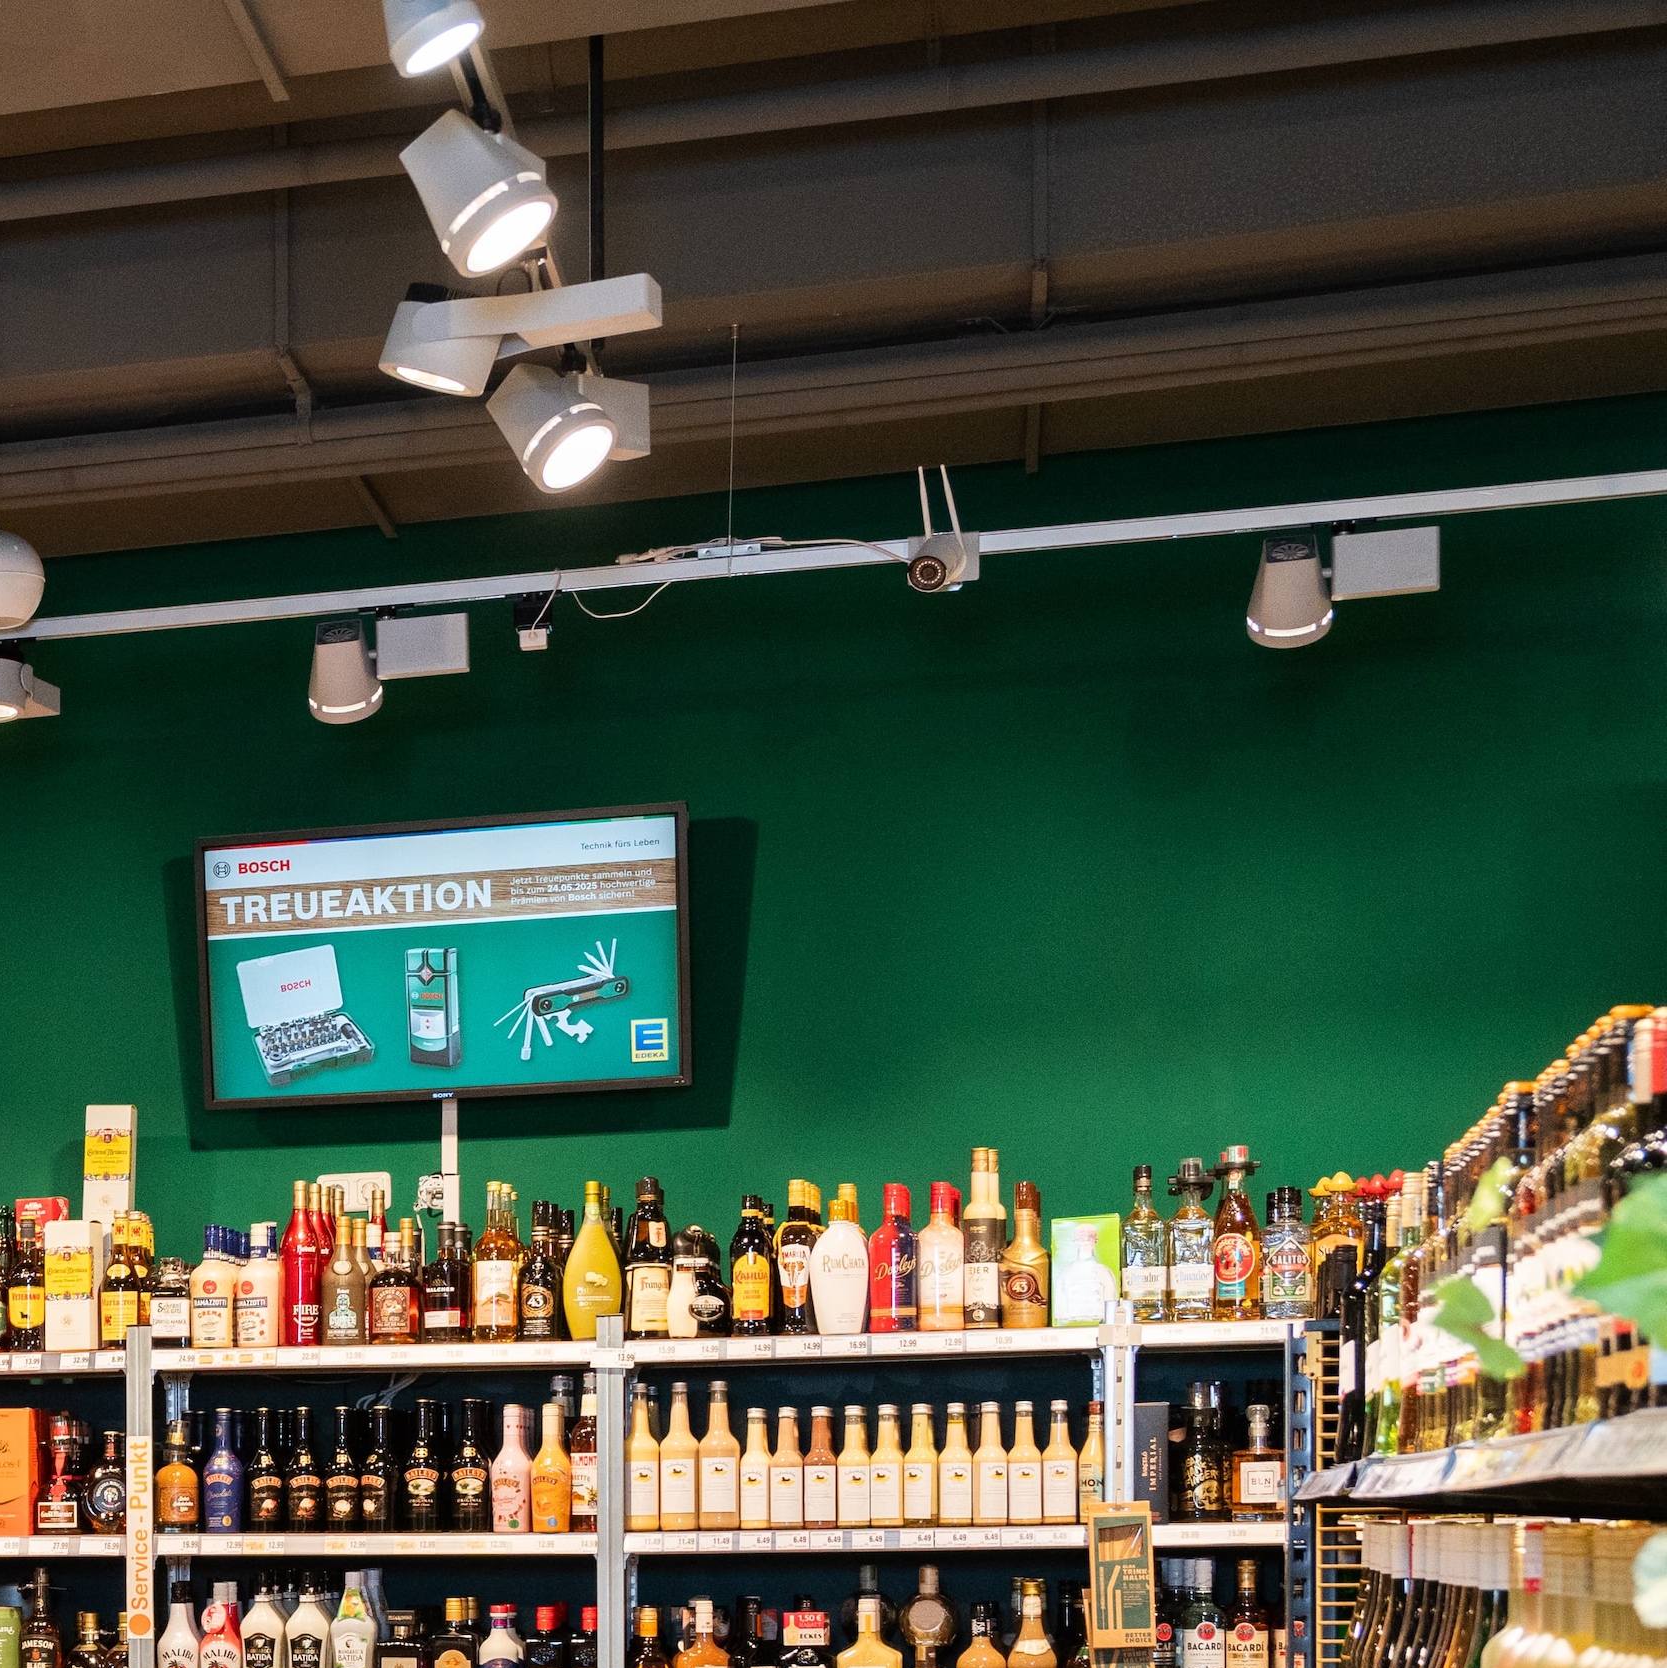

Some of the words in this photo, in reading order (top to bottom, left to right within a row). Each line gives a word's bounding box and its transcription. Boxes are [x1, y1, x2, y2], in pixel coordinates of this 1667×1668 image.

[581, 842, 612, 850] Technik
[238, 859, 290, 874] BOSCH
[510, 876, 532, 885] Jetzt
[535, 874, 590, 884] Treuepunkte
[592, 870, 632, 879] sammeln
[636, 868, 652, 876] und
[547, 882, 597, 892] 24.05.2025
[600, 878, 656, 889] hochwertige
[220, 879, 491, 925] TREUEAKTION
[511, 896, 546, 905] Prämien
[569, 892, 596, 901] Bosch
[599, 890, 635, 900] sichern!
[1271, 1255, 1307, 1265] SALITOS
[527, 1295, 544, 1307] 43
[129, 1442, 148, 1510] Punkt
[131, 1529, 148, 1610] Service
[798, 1613, 817, 1622] 1,50
[817, 1613, 822, 1622] €
[22, 1640, 54, 1648] JAMESON
[247, 1651, 272, 1663] BATIDA
